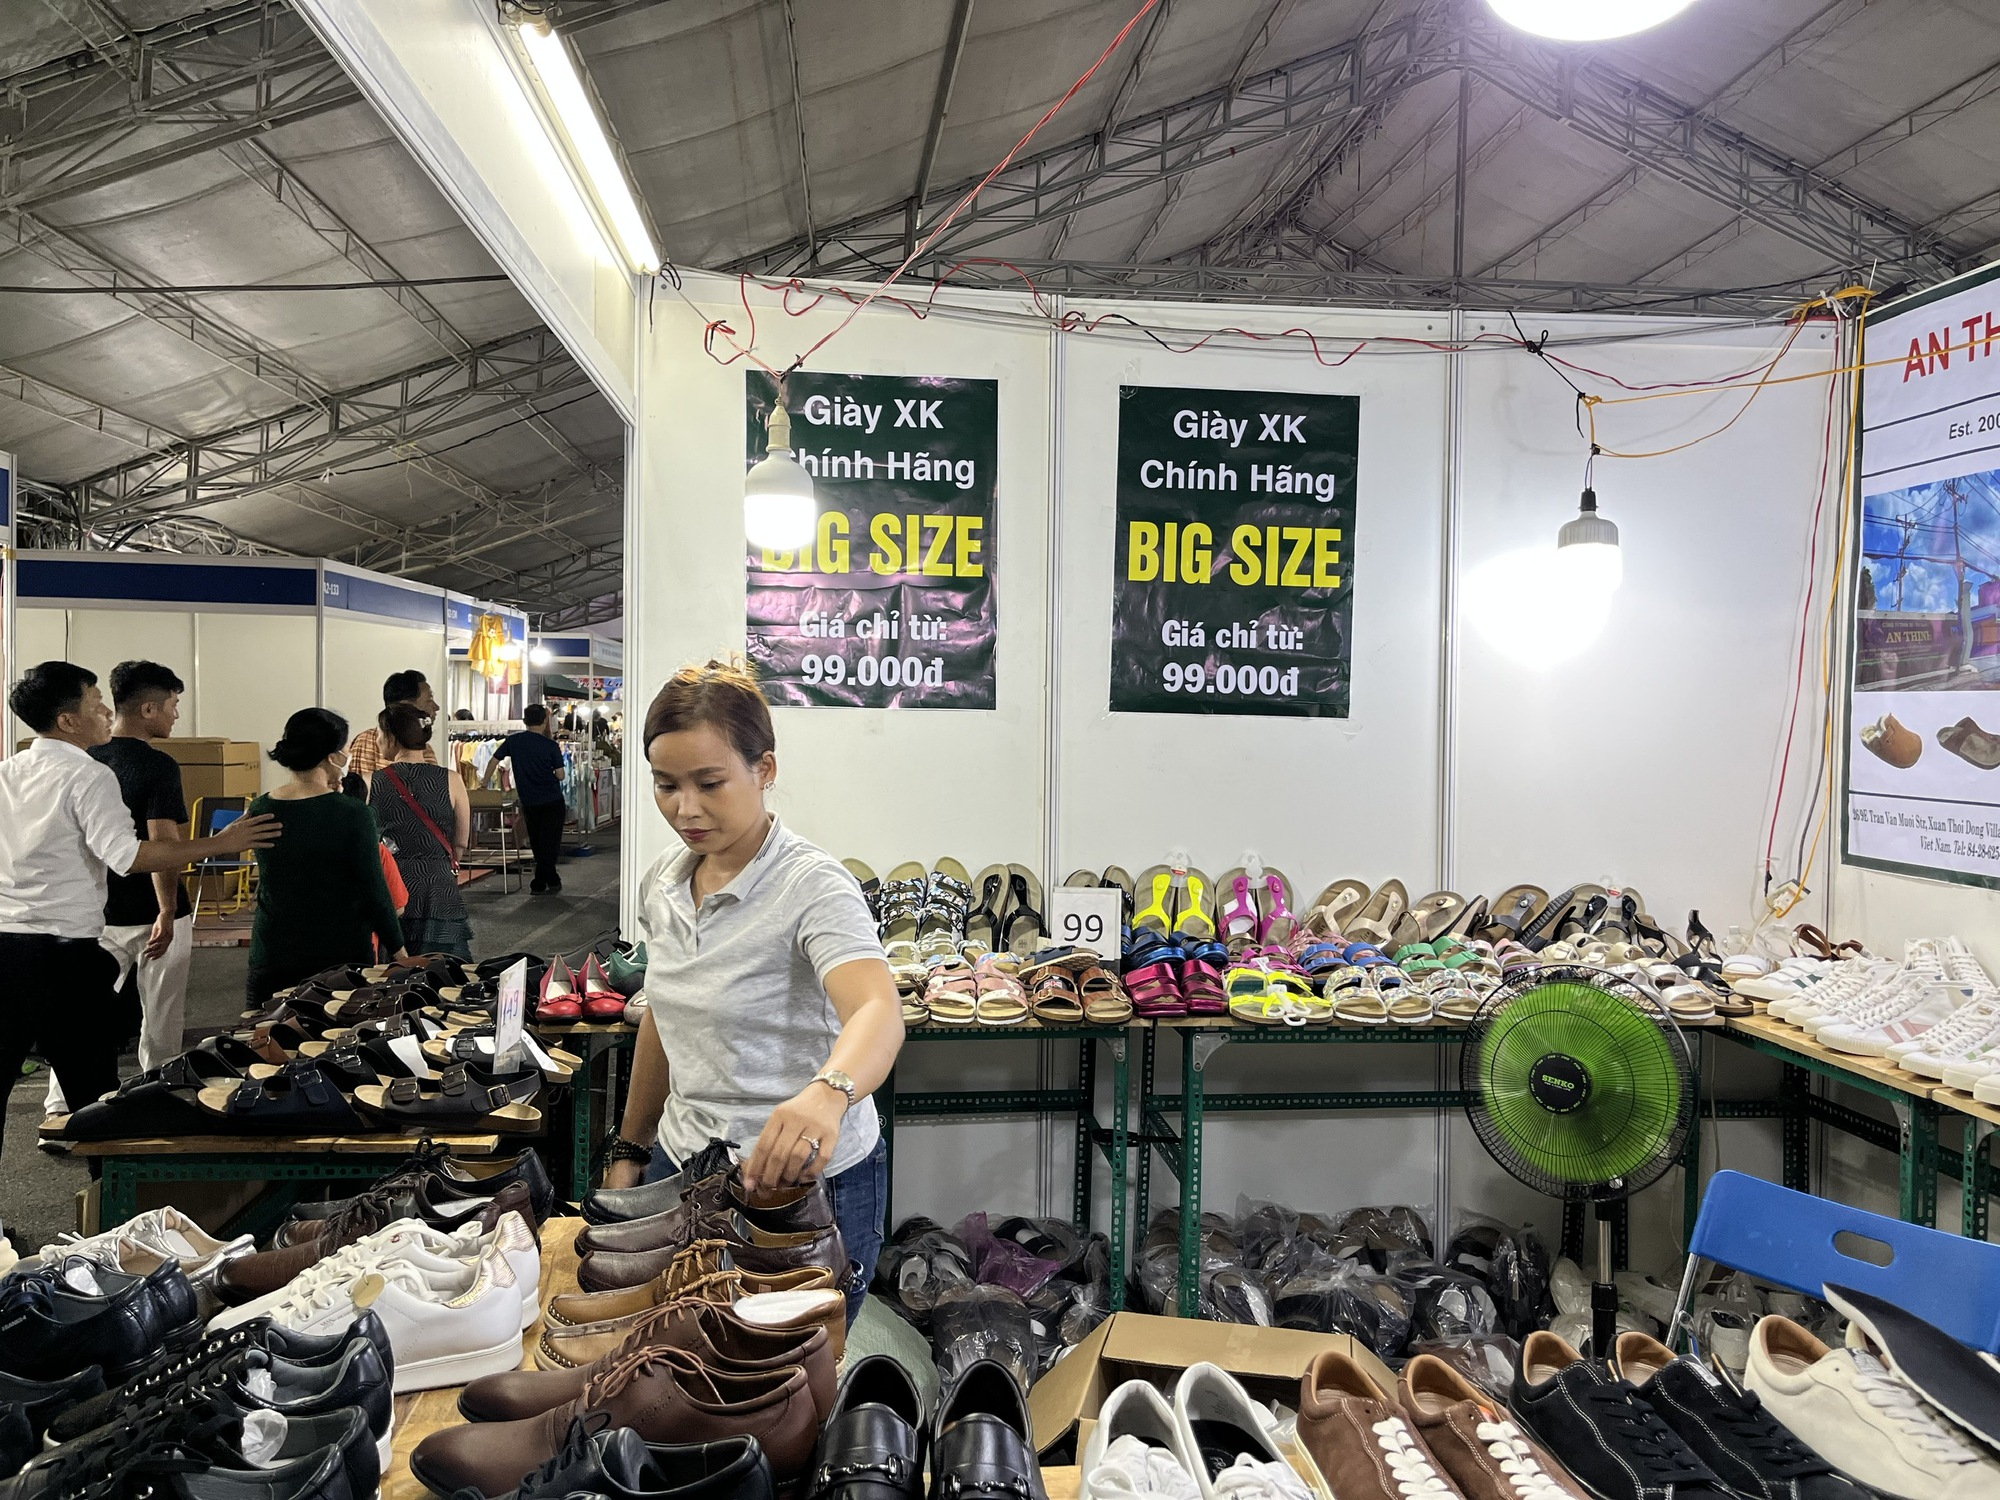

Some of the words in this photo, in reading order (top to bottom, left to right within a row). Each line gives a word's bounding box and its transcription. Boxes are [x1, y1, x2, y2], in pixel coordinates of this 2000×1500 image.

[1903, 326, 1950, 384] AN
[804, 394, 882, 434] Giày
[893, 398, 944, 429] XK
[1173, 409, 1248, 448] Giày
[1257, 413, 1307, 444] XK
[1949, 421, 1973, 440] Est.
[887, 451, 975, 490] Hãng
[1140, 459, 1238, 491] Chính
[1250, 464, 1336, 503] Hãng
[869, 512, 984, 578] SIZE
[1127, 520, 1213, 585] BIG
[1229, 524, 1343, 588] SIZE
[798, 610, 846, 640] Giá
[856, 609, 900, 641] chỉ
[908, 613, 947, 641] từ:
[1161, 619, 1206, 647] Giá
[1215, 620, 1258, 649] chỉ
[1266, 624, 1304, 651] từ:
[1886, 632, 1901, 643] AN
[801, 654, 945, 688] 99.000đ
[1162, 662, 1300, 697] 99.000đ
[1869, 810, 1884, 824] Tran
[1885, 812, 1897, 825] Van
[1899, 813, 1914, 828] Muoi
[1927, 816, 1947, 832] Xuan
[1947, 818, 1964, 834] Thoi
[1965, 819, 1985, 840] Dong
[1920, 835, 1934, 851] Viet
[1063, 913, 1104, 943] 99
[1542, 1075, 1574, 1089] SENKO
